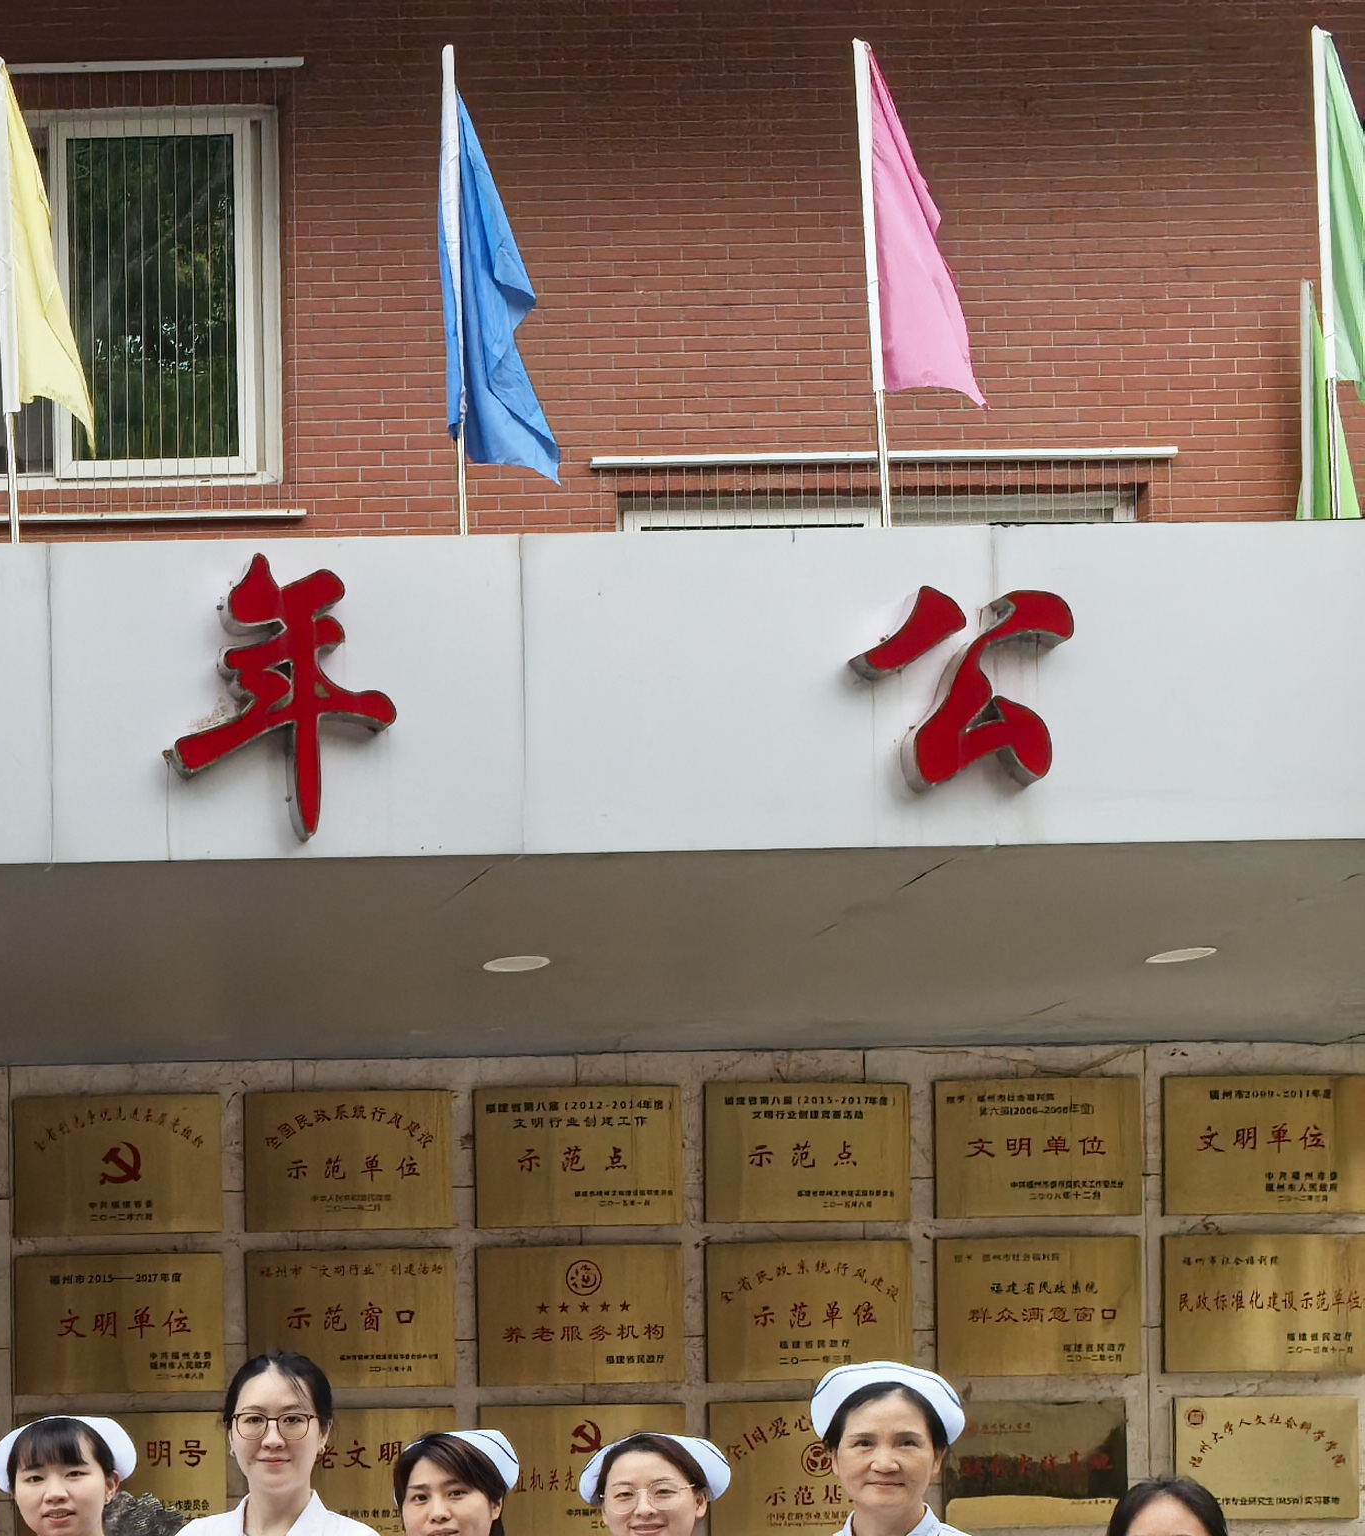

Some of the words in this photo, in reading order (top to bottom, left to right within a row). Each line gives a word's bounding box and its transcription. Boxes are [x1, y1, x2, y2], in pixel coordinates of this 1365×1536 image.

[265, 1104, 435, 1150] 全国民政系统行风建设
[513, 1115, 648, 1129] 文明行业创建工作
[965, 1136, 1107, 1158] 文明单位
[1197, 1123, 1326, 1153] 文明单位
[518, 1146, 627, 1173] 示范点
[748, 1140, 857, 1168] 示范点
[286, 1154, 421, 1182] 示范单位
[721, 1259, 900, 1304] 全省民政系统行风建设
[990, 1281, 1098, 1296] 福建省民政系统
[1179, 1288, 1363, 1315] 民政标准化建设示范单位
[57, 1306, 192, 1339] 文明单位
[287, 1302, 416, 1332] 示范窗口
[753, 1301, 878, 1329] 示范单位
[968, 1306, 1117, 1324] 群众满意窗口
[502, 1323, 665, 1344] 养老服务机构
[779, 1339, 851, 1350] 福建省民政厅
[1287, 1332, 1353, 1342] 福建省民政厅
[605, 1355, 665, 1365] 福建省民政厅
[1063, 1343, 1126, 1353] 福建省民政厅
[149, 1361, 212, 1370] 福州市人民政府
[726, 1414, 813, 1461] 全国爱心
[765, 1484, 854, 1506] 示范基
